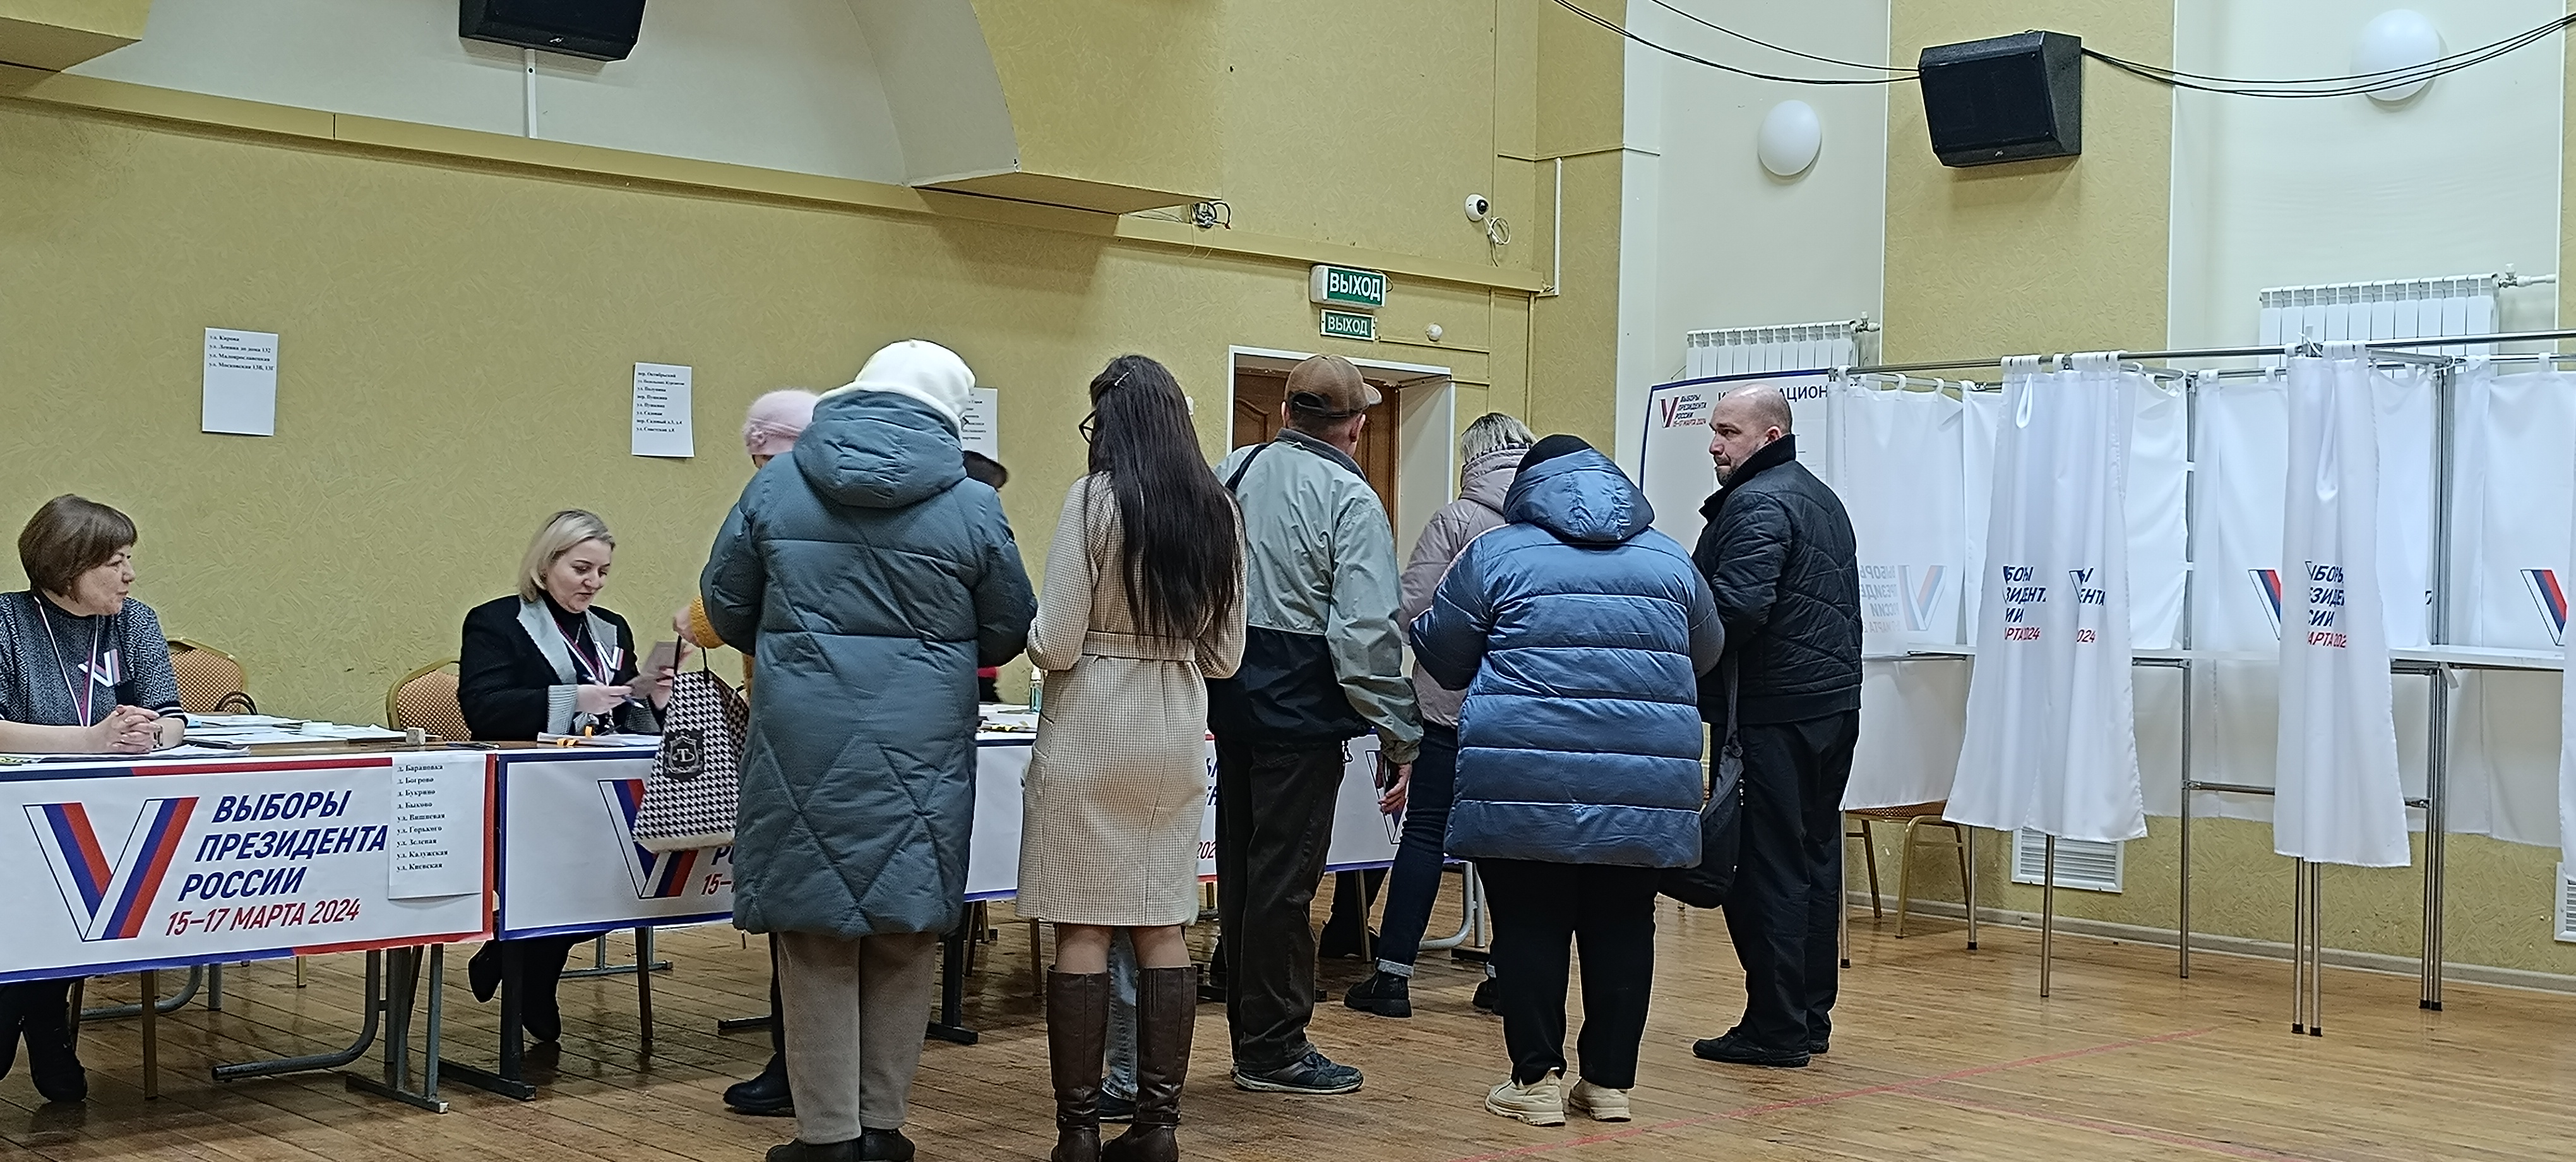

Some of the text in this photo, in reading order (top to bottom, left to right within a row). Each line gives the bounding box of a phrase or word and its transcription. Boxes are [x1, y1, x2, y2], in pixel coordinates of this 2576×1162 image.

[1330, 272, 1381, 302] ВЫХОД
[1328, 316, 1368, 336] ВЫХОД
[211, 790, 352, 824] ВЫБОРЫ
[194, 825, 389, 863] ПРЕЗИДЕНТА
[410, 826, 443, 834] Горького
[409, 850, 448, 858] Калужская
[177, 866, 307, 902] РОССИИ
[165, 898, 361, 936] 15–17 МАРТА 2024
